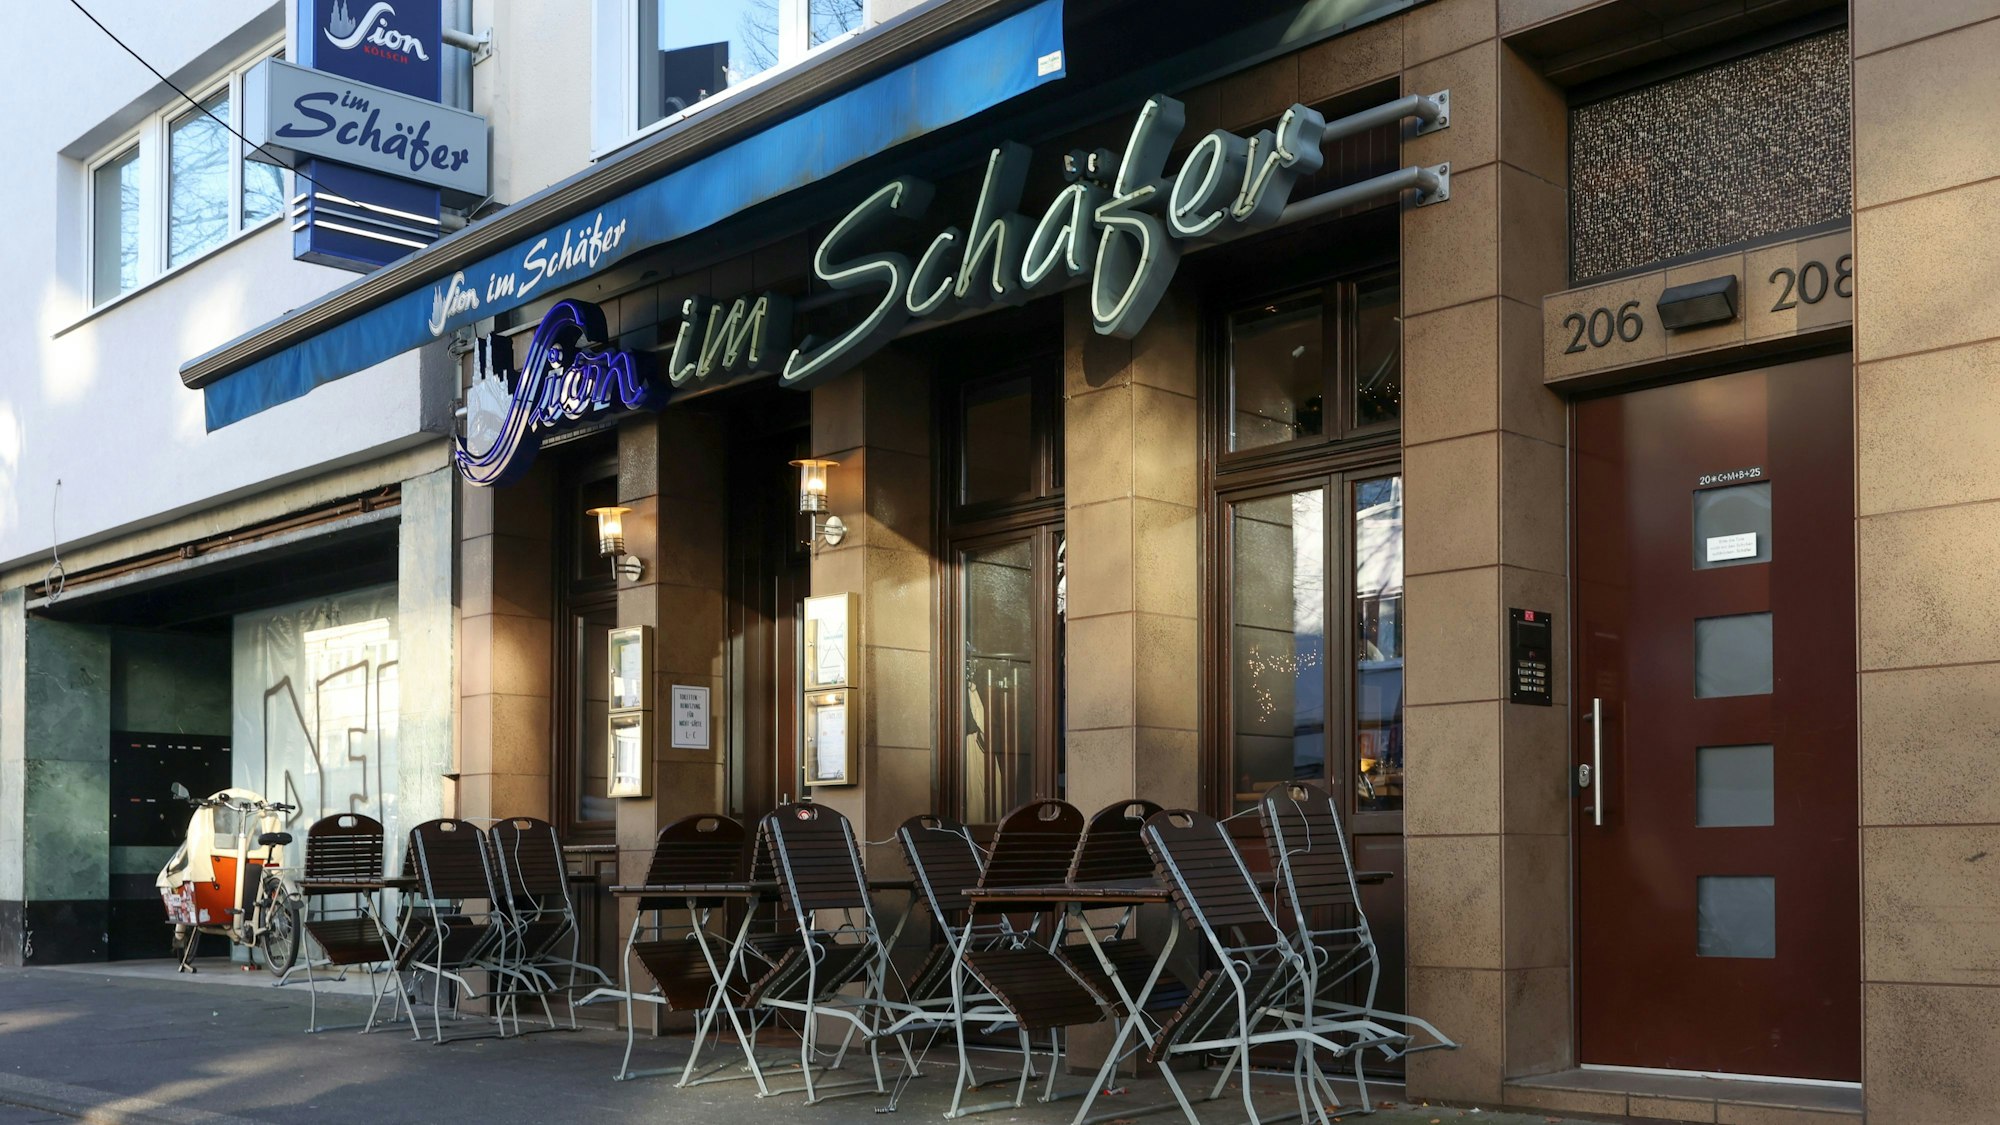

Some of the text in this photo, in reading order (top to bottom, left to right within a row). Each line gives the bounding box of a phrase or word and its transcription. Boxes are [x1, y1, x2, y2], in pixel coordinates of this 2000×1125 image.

[323, 1, 430, 62] Sion
[363, 44, 409, 65] KÖLSCH
[274, 91, 470, 172] Schäfer
[340, 90, 370, 113] im
[667, 95, 1322, 389] im Schäfer
[428, 211, 627, 337] Sion im Schäfer
[1768, 253, 1853, 313] 208
[1563, 300, 1644, 355] 206
[454, 298, 650, 487] Sion
